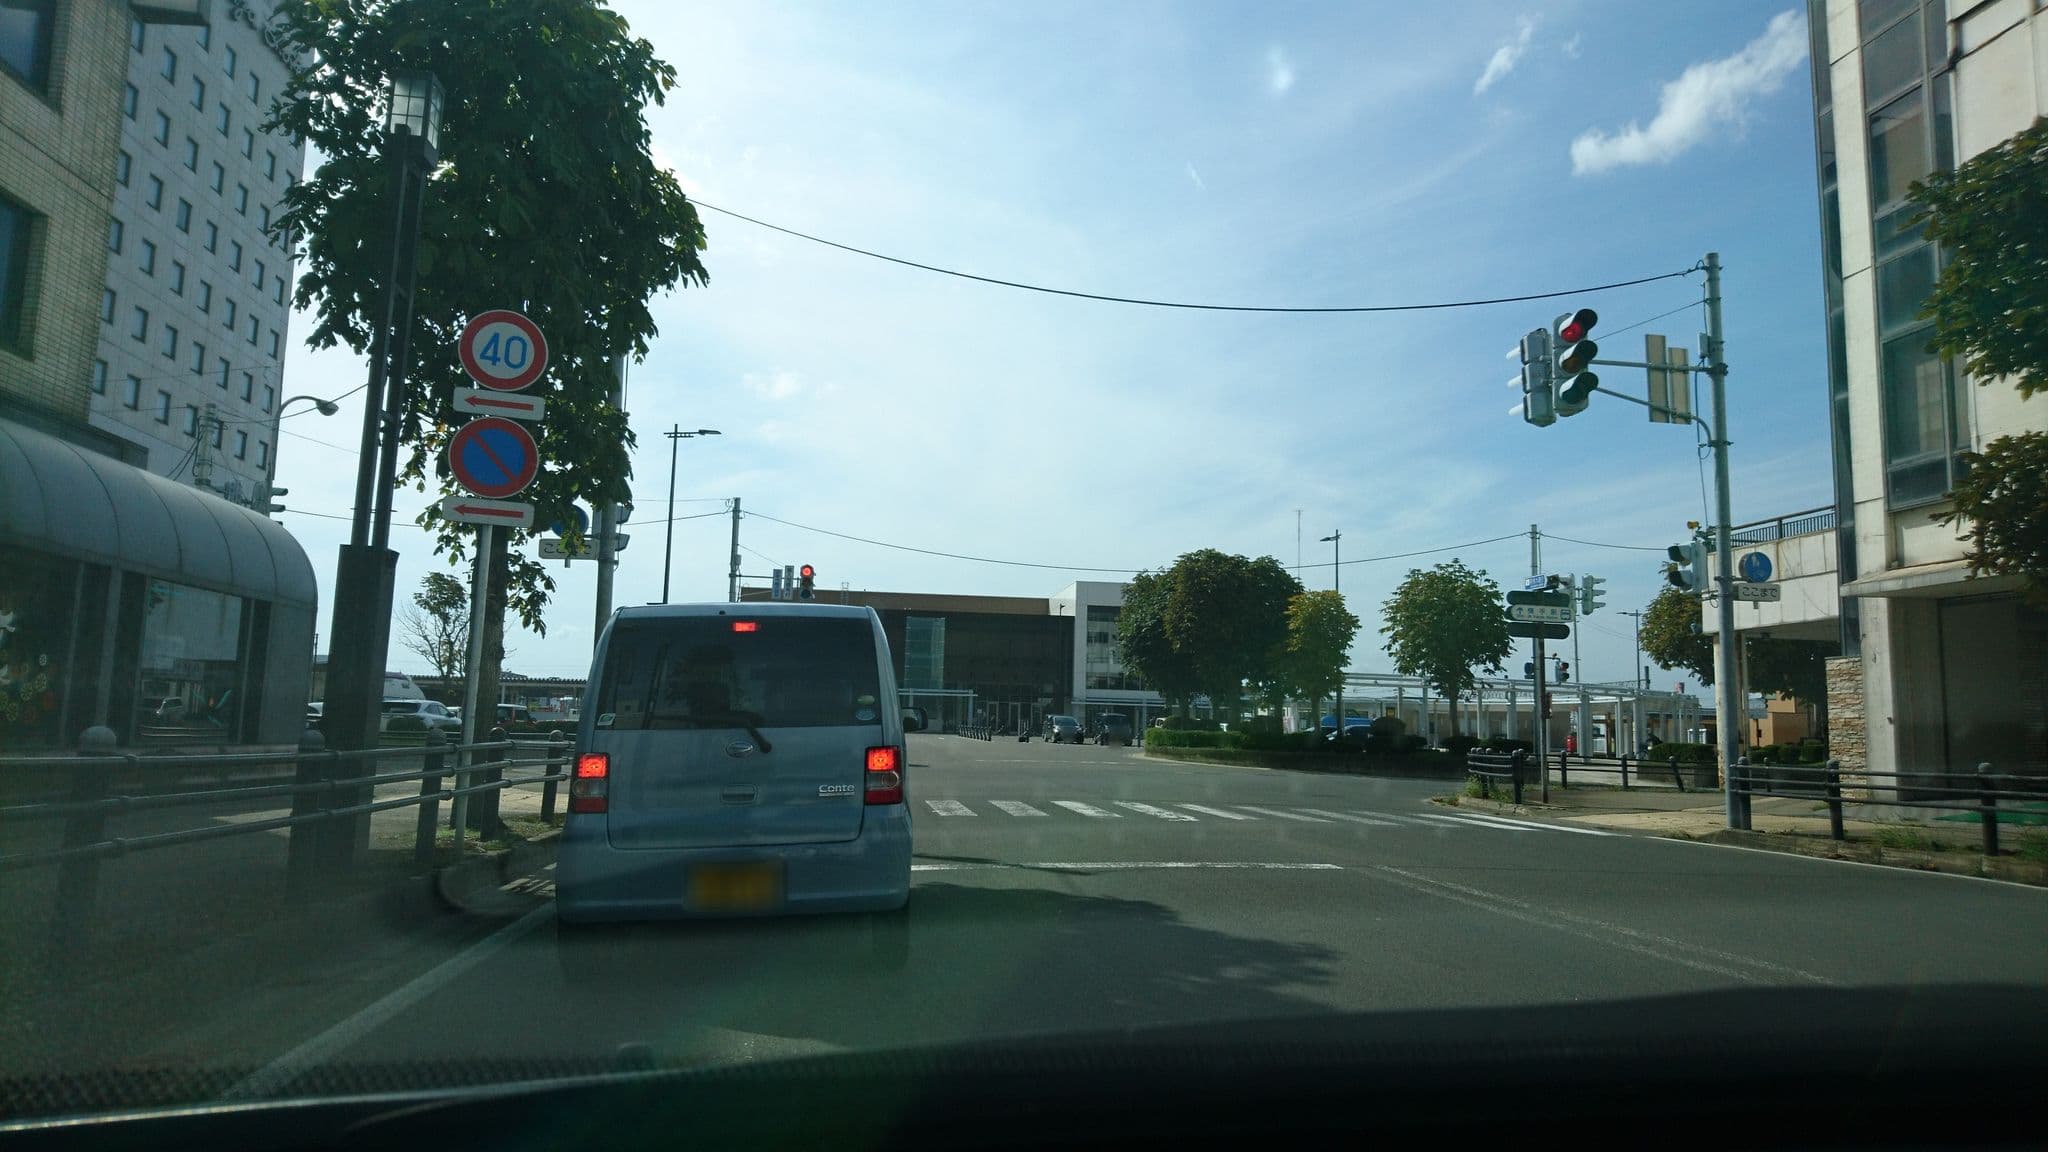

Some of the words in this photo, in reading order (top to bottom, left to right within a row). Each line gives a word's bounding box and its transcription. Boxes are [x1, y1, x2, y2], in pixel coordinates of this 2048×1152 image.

[480, 332, 527, 369] 40
[1742, 586, 1778, 598] ここまで
[819, 784, 855, 794] Conte
